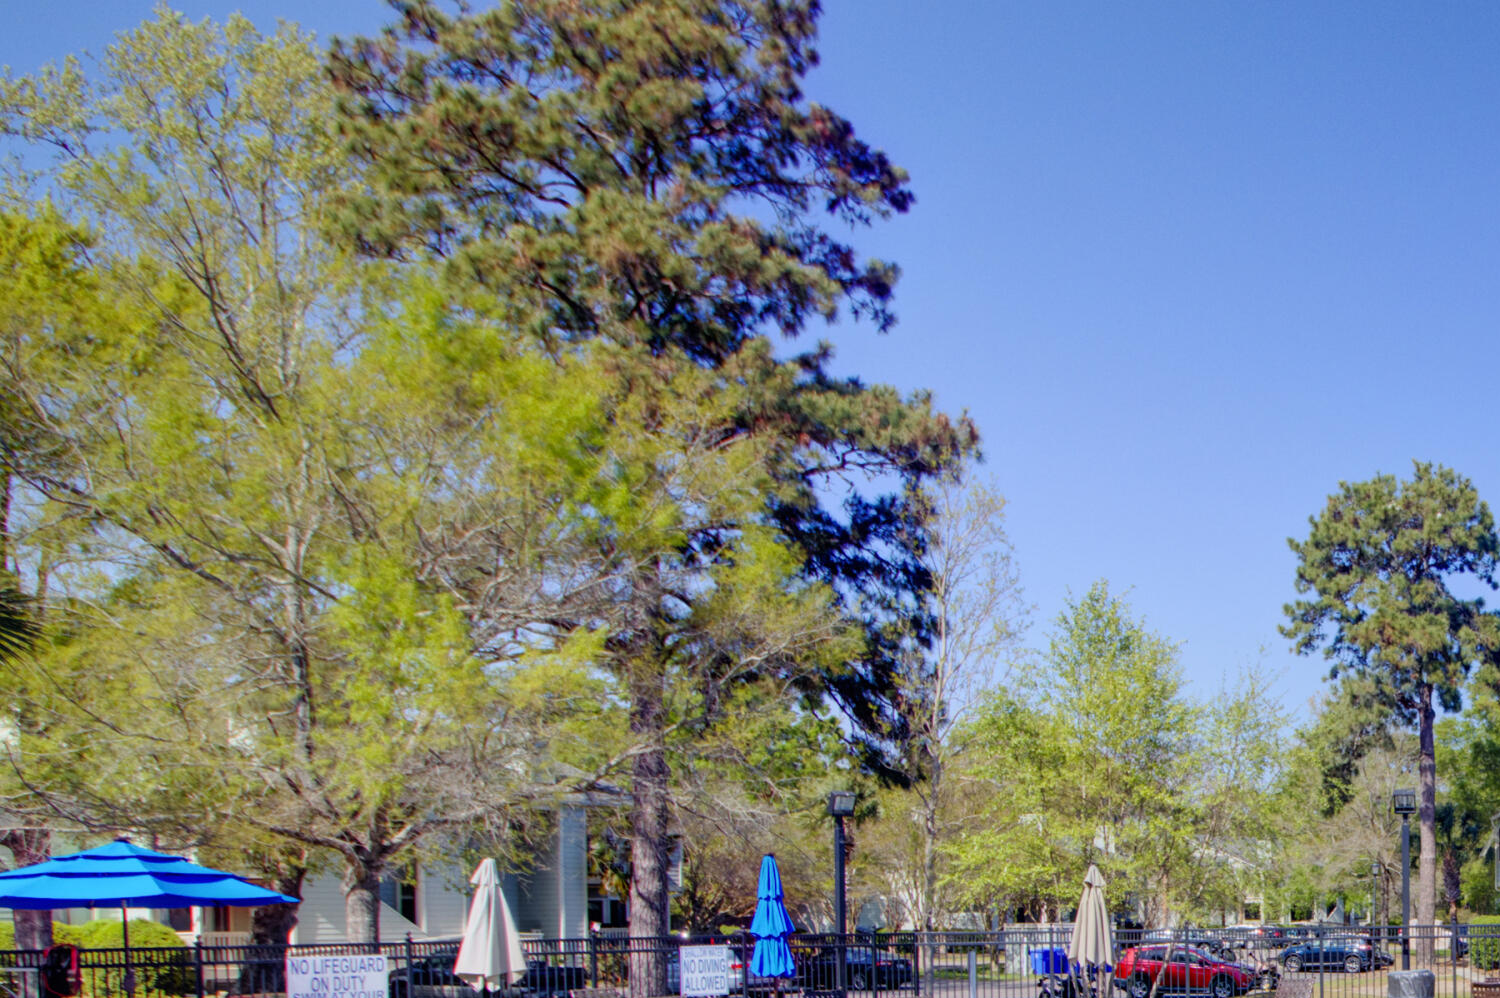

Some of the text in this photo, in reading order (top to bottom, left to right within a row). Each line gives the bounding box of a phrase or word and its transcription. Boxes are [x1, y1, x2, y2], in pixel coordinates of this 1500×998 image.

[290, 957, 385, 975] NO LIFEGUARD
[684, 958, 726, 974] NO DIVING
[311, 975, 366, 992] ON DUTY
[685, 975, 726, 991] ALLOWED
